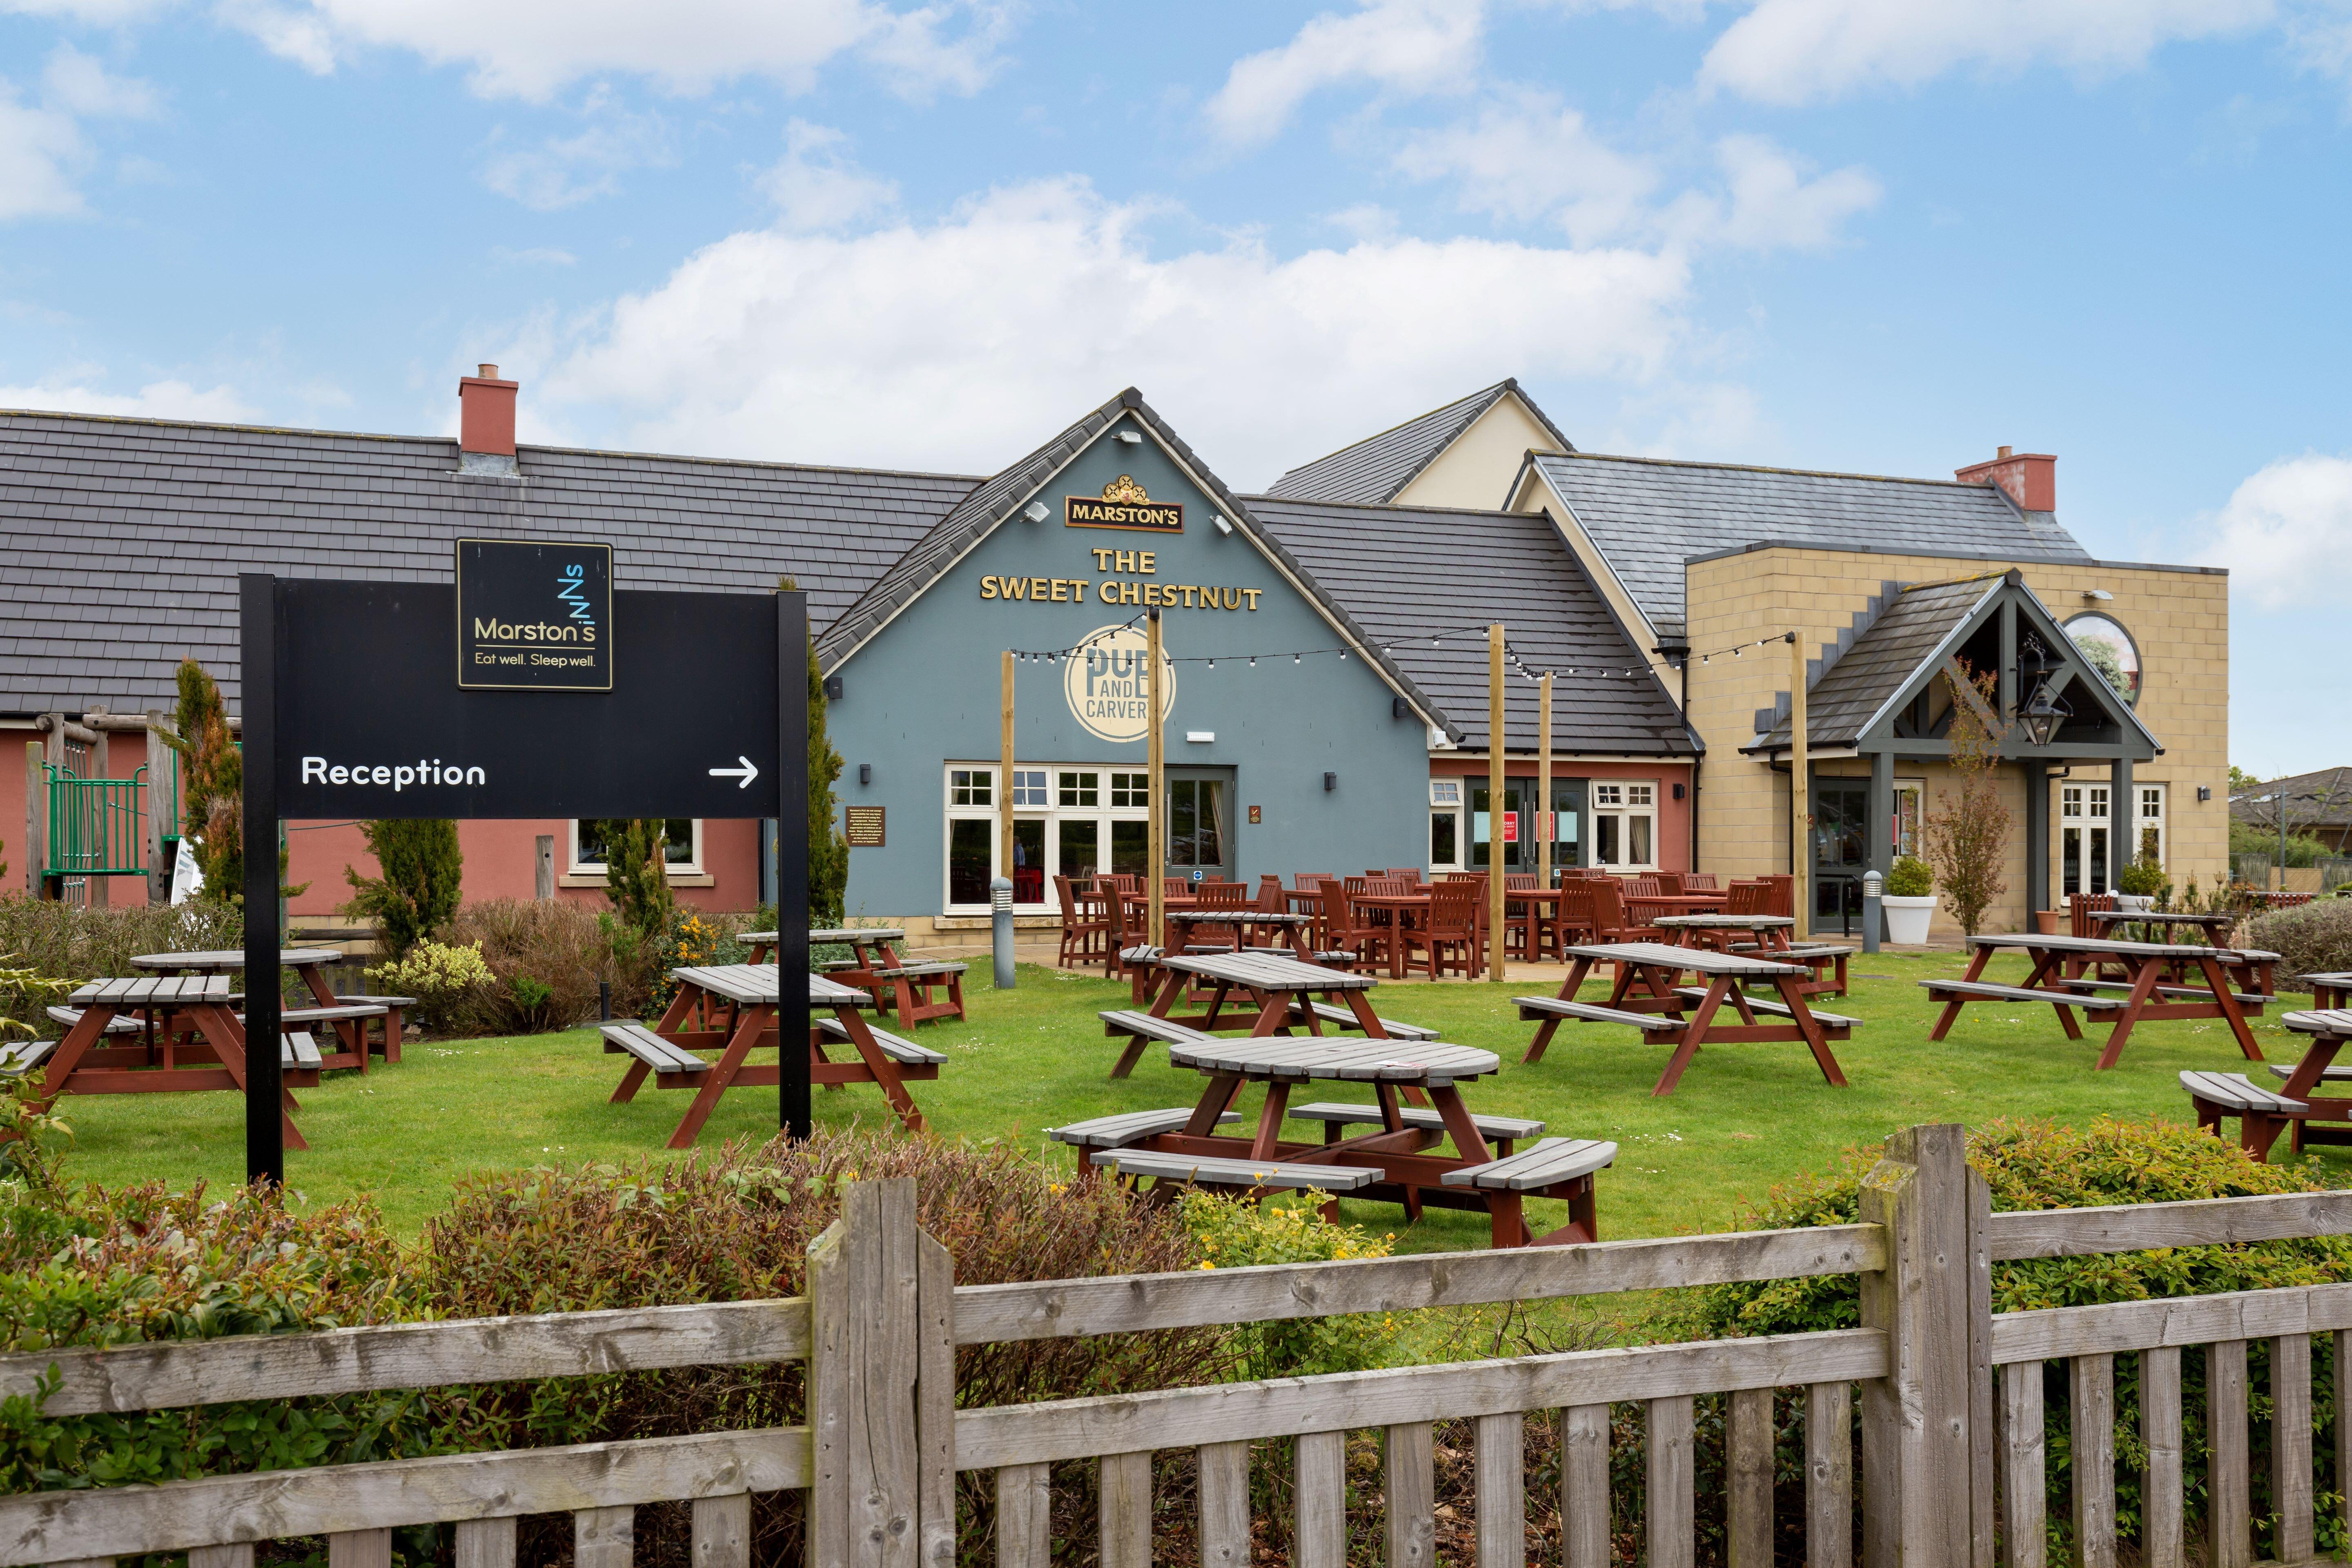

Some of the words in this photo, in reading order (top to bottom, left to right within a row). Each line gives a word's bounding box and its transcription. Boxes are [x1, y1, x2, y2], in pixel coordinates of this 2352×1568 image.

[1072, 504, 1178, 525] MARSTON'S
[1091, 548, 1156, 574] THE
[980, 575, 1089, 603] SWEET
[1098, 580, 1262, 610] CHESTNUT
[475, 652, 497, 664] Eat
[499, 653, 527, 665] well.
[530, 654, 568, 668] Sleep
[569, 655, 596, 667] well.
[1100, 679, 1132, 698] AND
[1086, 699, 1149, 719] CARVER
[302, 757, 485, 792] Reception
